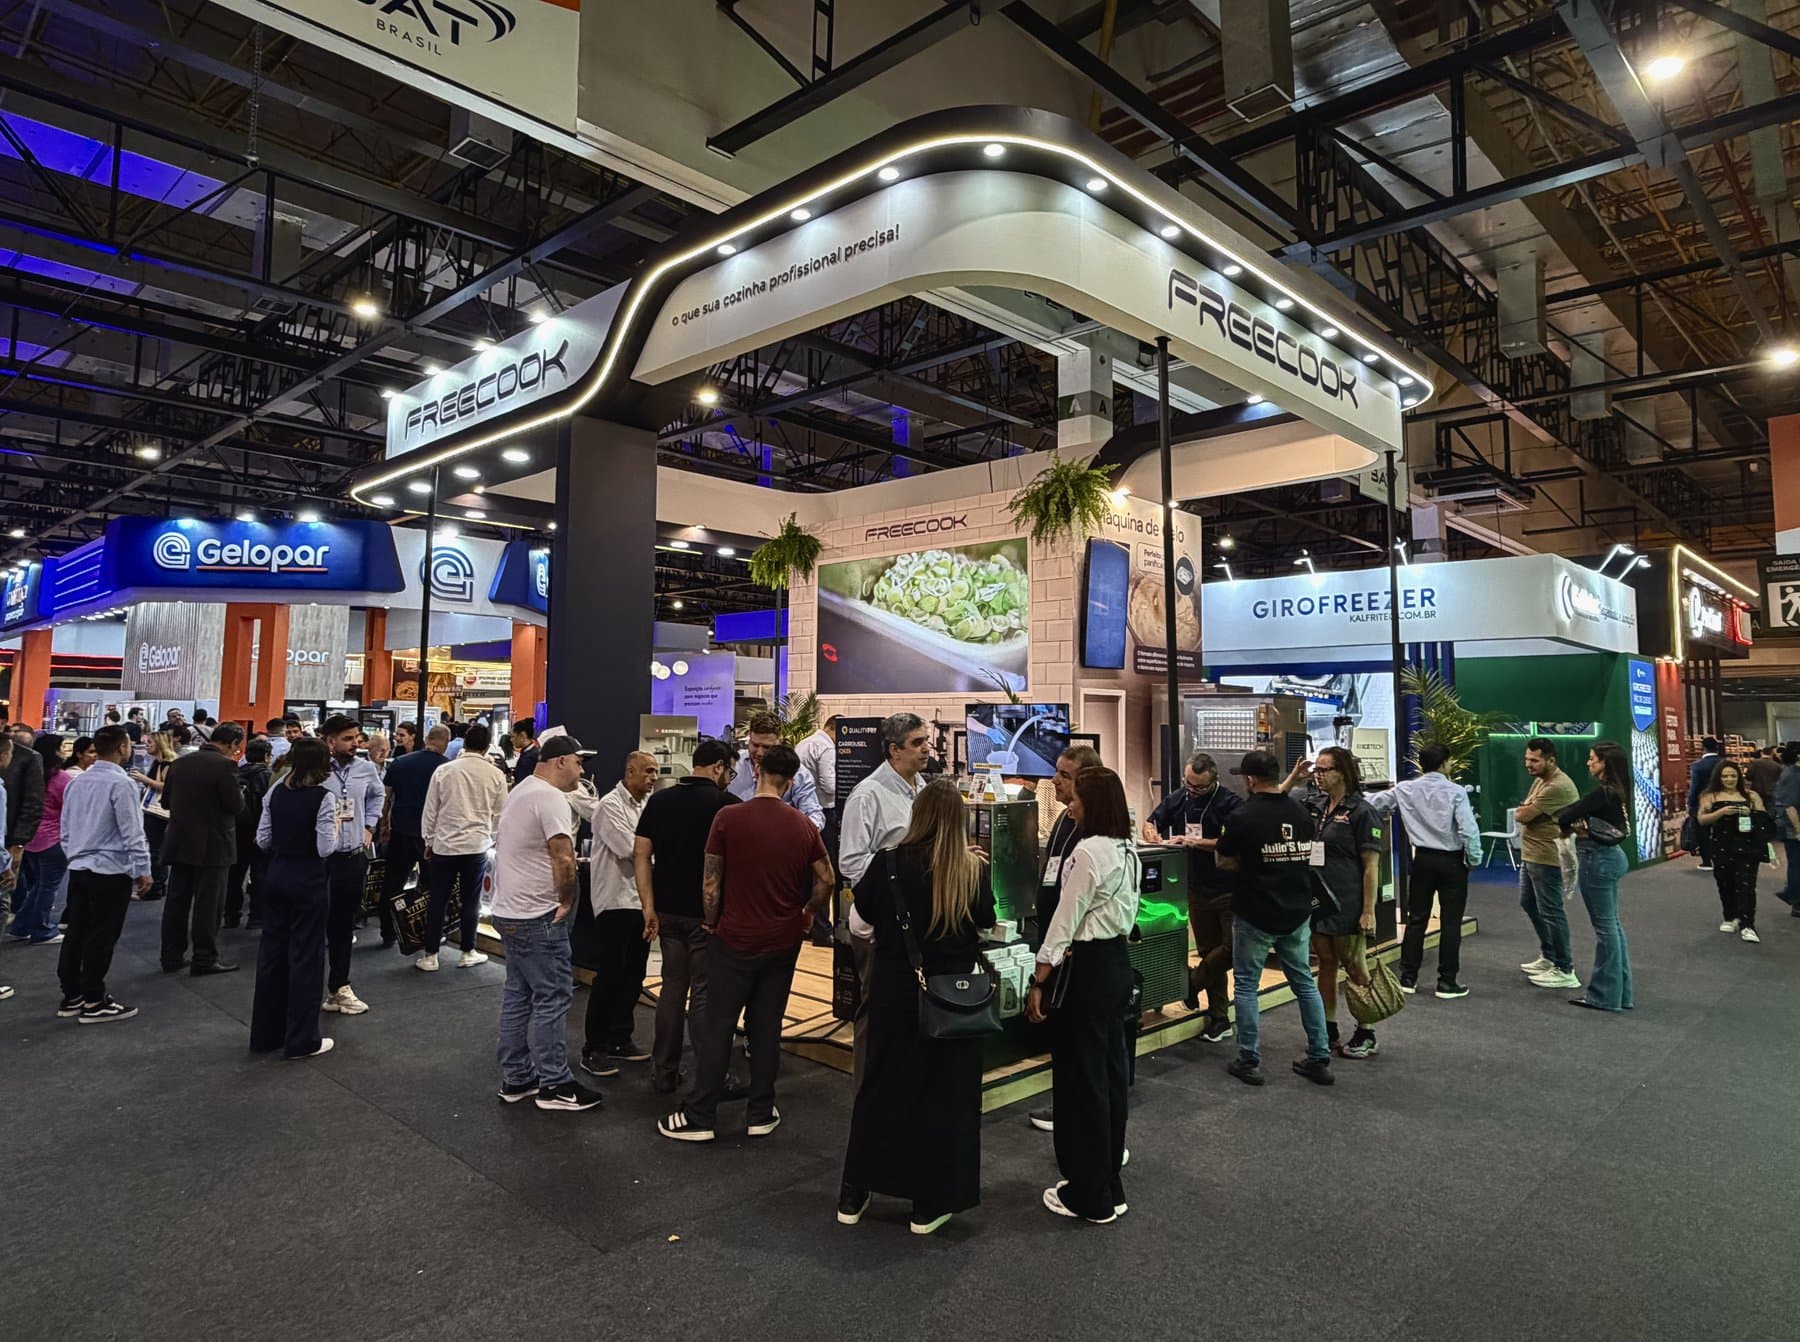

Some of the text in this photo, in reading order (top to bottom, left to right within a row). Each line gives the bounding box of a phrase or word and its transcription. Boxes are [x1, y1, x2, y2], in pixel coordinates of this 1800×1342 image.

[376, 18, 442, 56] BRASIL
[672, 223, 900, 326] o que sua cozinha profissional precisa!
[1169, 268, 1359, 410] FREECOOK
[404, 339, 569, 441] FREECOOK
[865, 514, 968, 542] FREECOOK
[1145, 518, 1159, 537] de
[197, 539, 330, 573] Gelopar
[1252, 588, 1437, 619] GIROFREEZER
[149, 645, 181, 668] Gelopar
